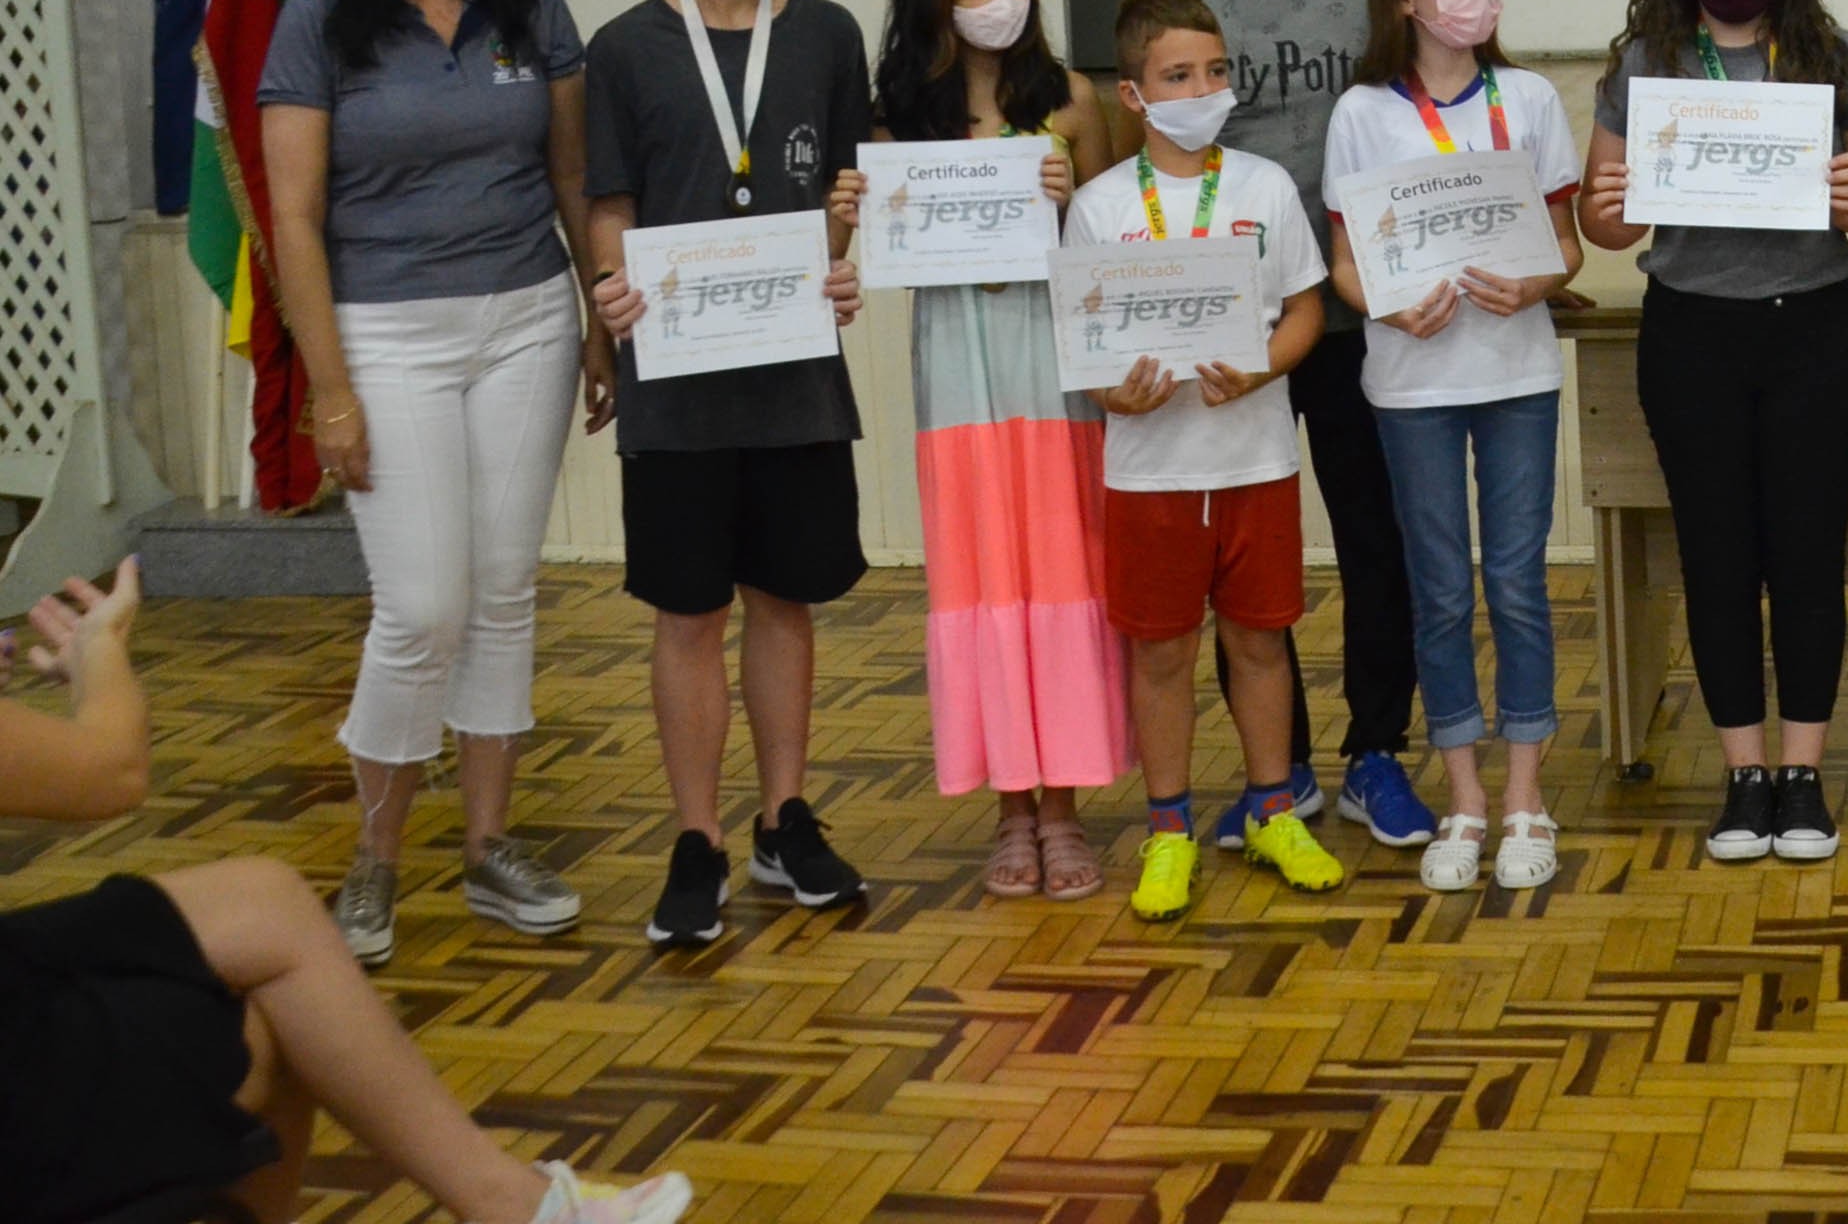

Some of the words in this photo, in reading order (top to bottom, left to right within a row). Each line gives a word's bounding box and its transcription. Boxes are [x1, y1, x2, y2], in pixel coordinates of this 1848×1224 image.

[1669, 102, 1760, 120] Certificado
[1686, 132, 1798, 174] jergs
[907, 163, 998, 180] Certificado
[1390, 173, 1483, 201] Certificado
[915, 193, 1028, 232] jergs
[1411, 203, 1519, 250] jergs
[666, 243, 756, 265] Certificado
[1091, 263, 1184, 281] Certificado
[689, 274, 801, 317] jergs
[1114, 293, 1230, 332] jergs
